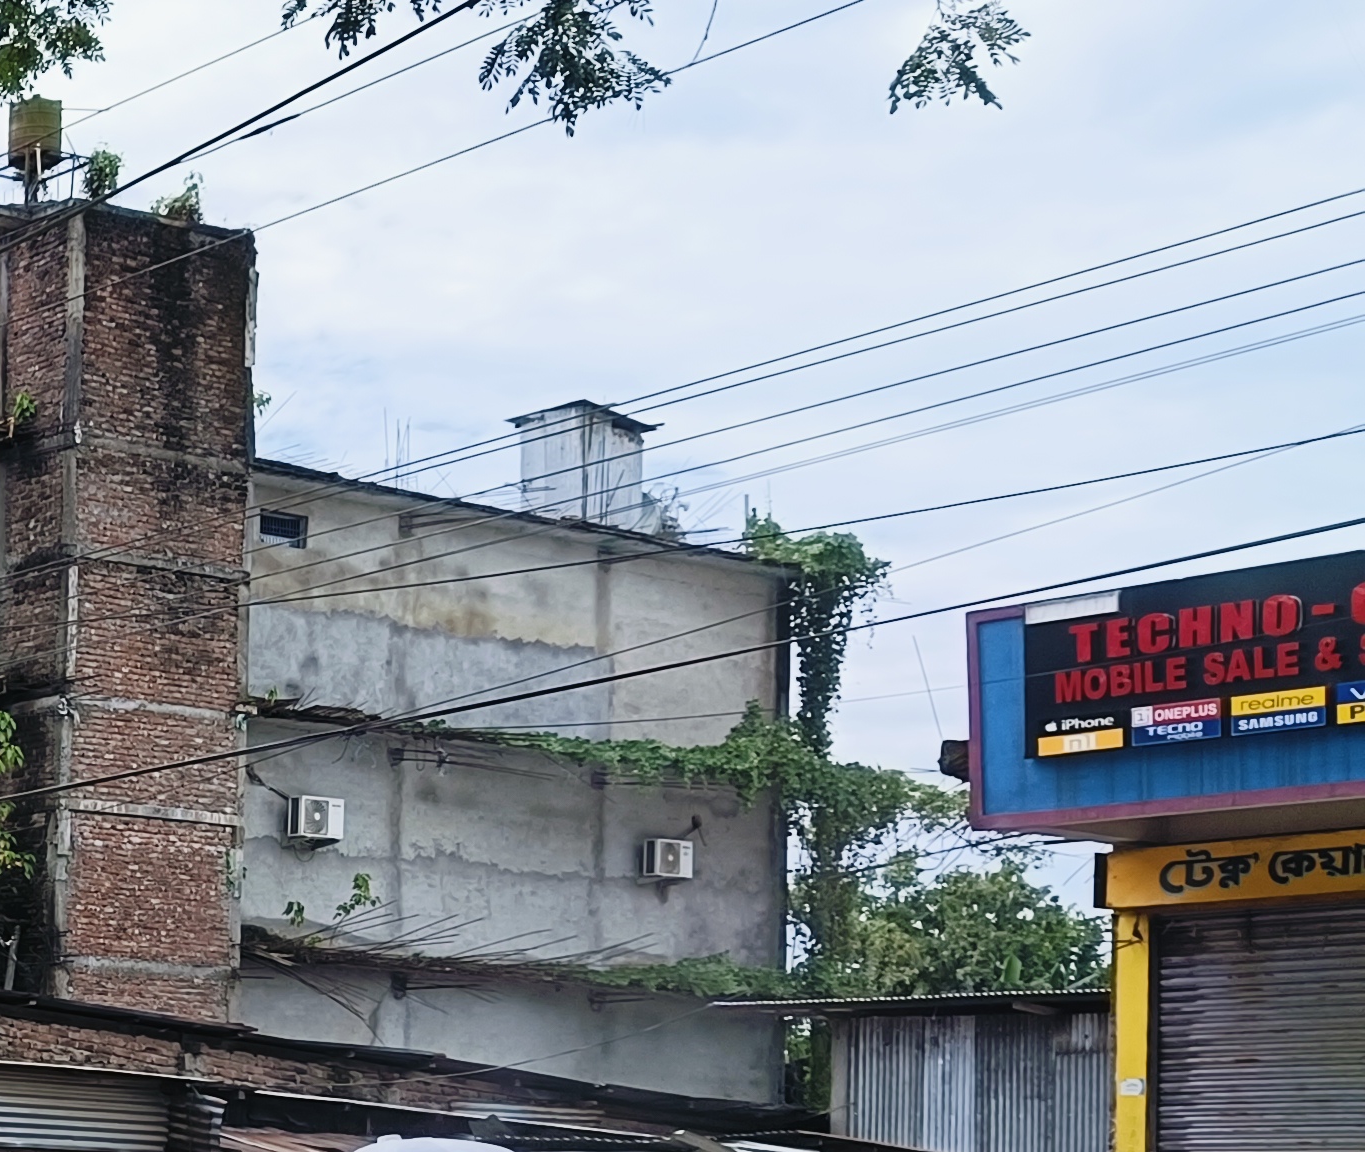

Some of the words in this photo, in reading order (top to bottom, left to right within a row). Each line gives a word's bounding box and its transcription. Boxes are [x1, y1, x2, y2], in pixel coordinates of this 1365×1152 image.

[1055, 657, 1188, 704] MOBILE
[1203, 642, 1300, 686] SALE
[1315, 637, 1342, 671] &
[1241, 694, 1314, 711] realme
[1154, 703, 1218, 722] ONEPLUS
[1238, 711, 1318, 731] SAMSUNG
[1061, 716, 1115, 731] iPhone
[1146, 722, 1204, 737] TECNO
[1268, 843, 1365, 884] কেয়া
